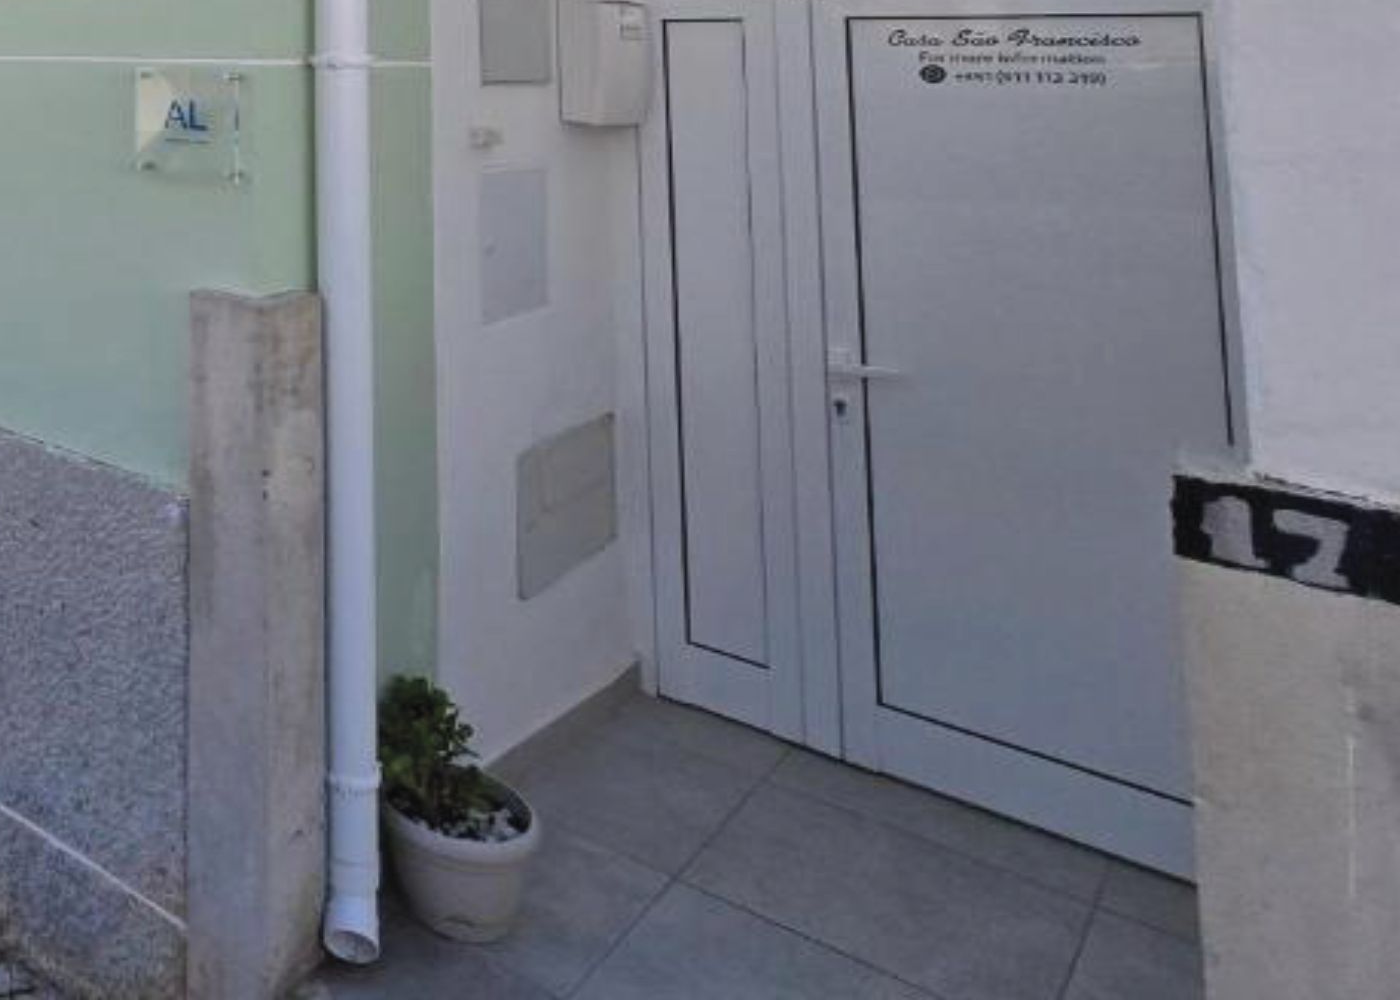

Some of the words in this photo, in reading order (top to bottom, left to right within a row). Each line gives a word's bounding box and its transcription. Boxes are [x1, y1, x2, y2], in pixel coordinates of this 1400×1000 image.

[888, 29, 944, 47] Casa
[951, 29, 1000, 47] São
[1007, 28, 1142, 48] Francisco
[164, 99, 209, 131] AL
[1201, 495, 1350, 590] 17
